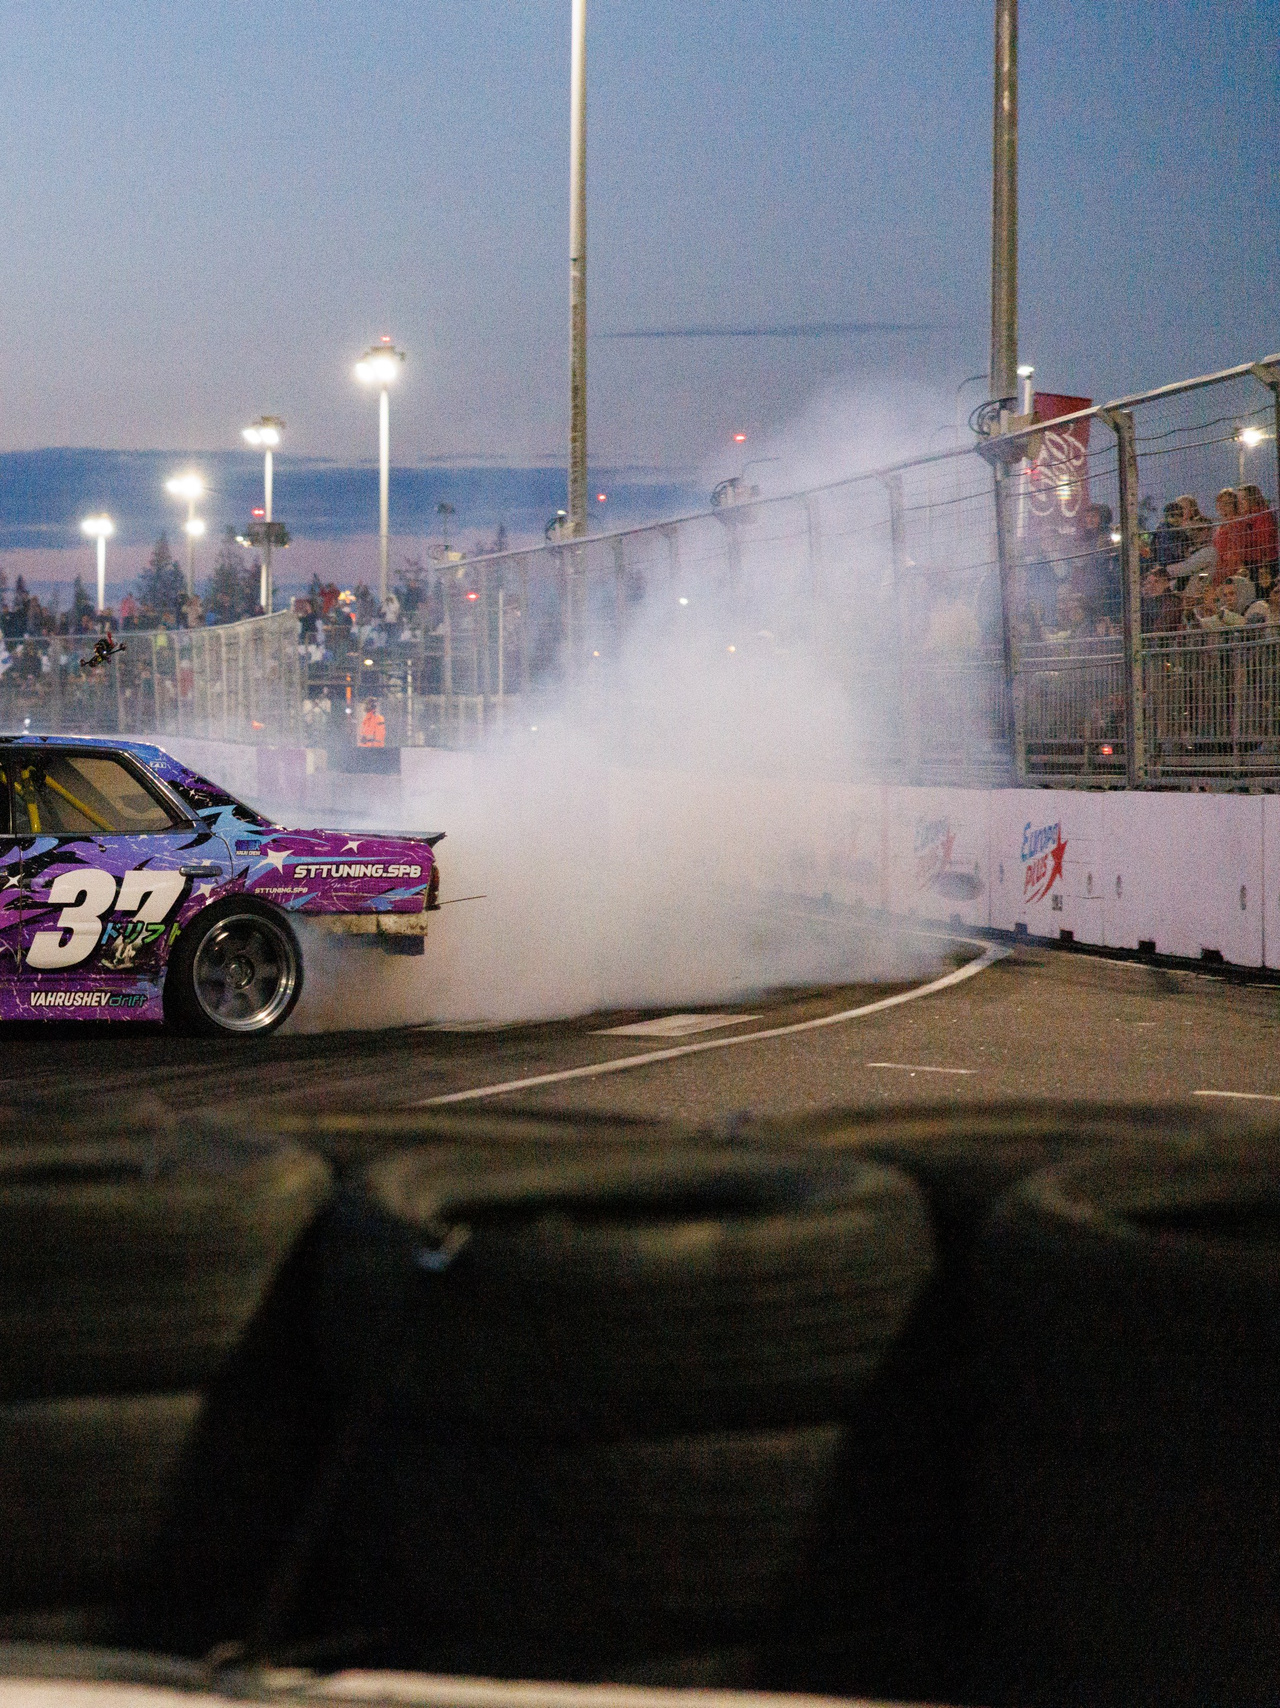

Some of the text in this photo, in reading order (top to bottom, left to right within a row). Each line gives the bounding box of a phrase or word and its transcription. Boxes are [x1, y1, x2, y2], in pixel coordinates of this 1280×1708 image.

[293, 864, 422, 879] STTUNING.SPB
[25, 868, 187, 969] 37
[100, 921, 182, 946] ドリフト
